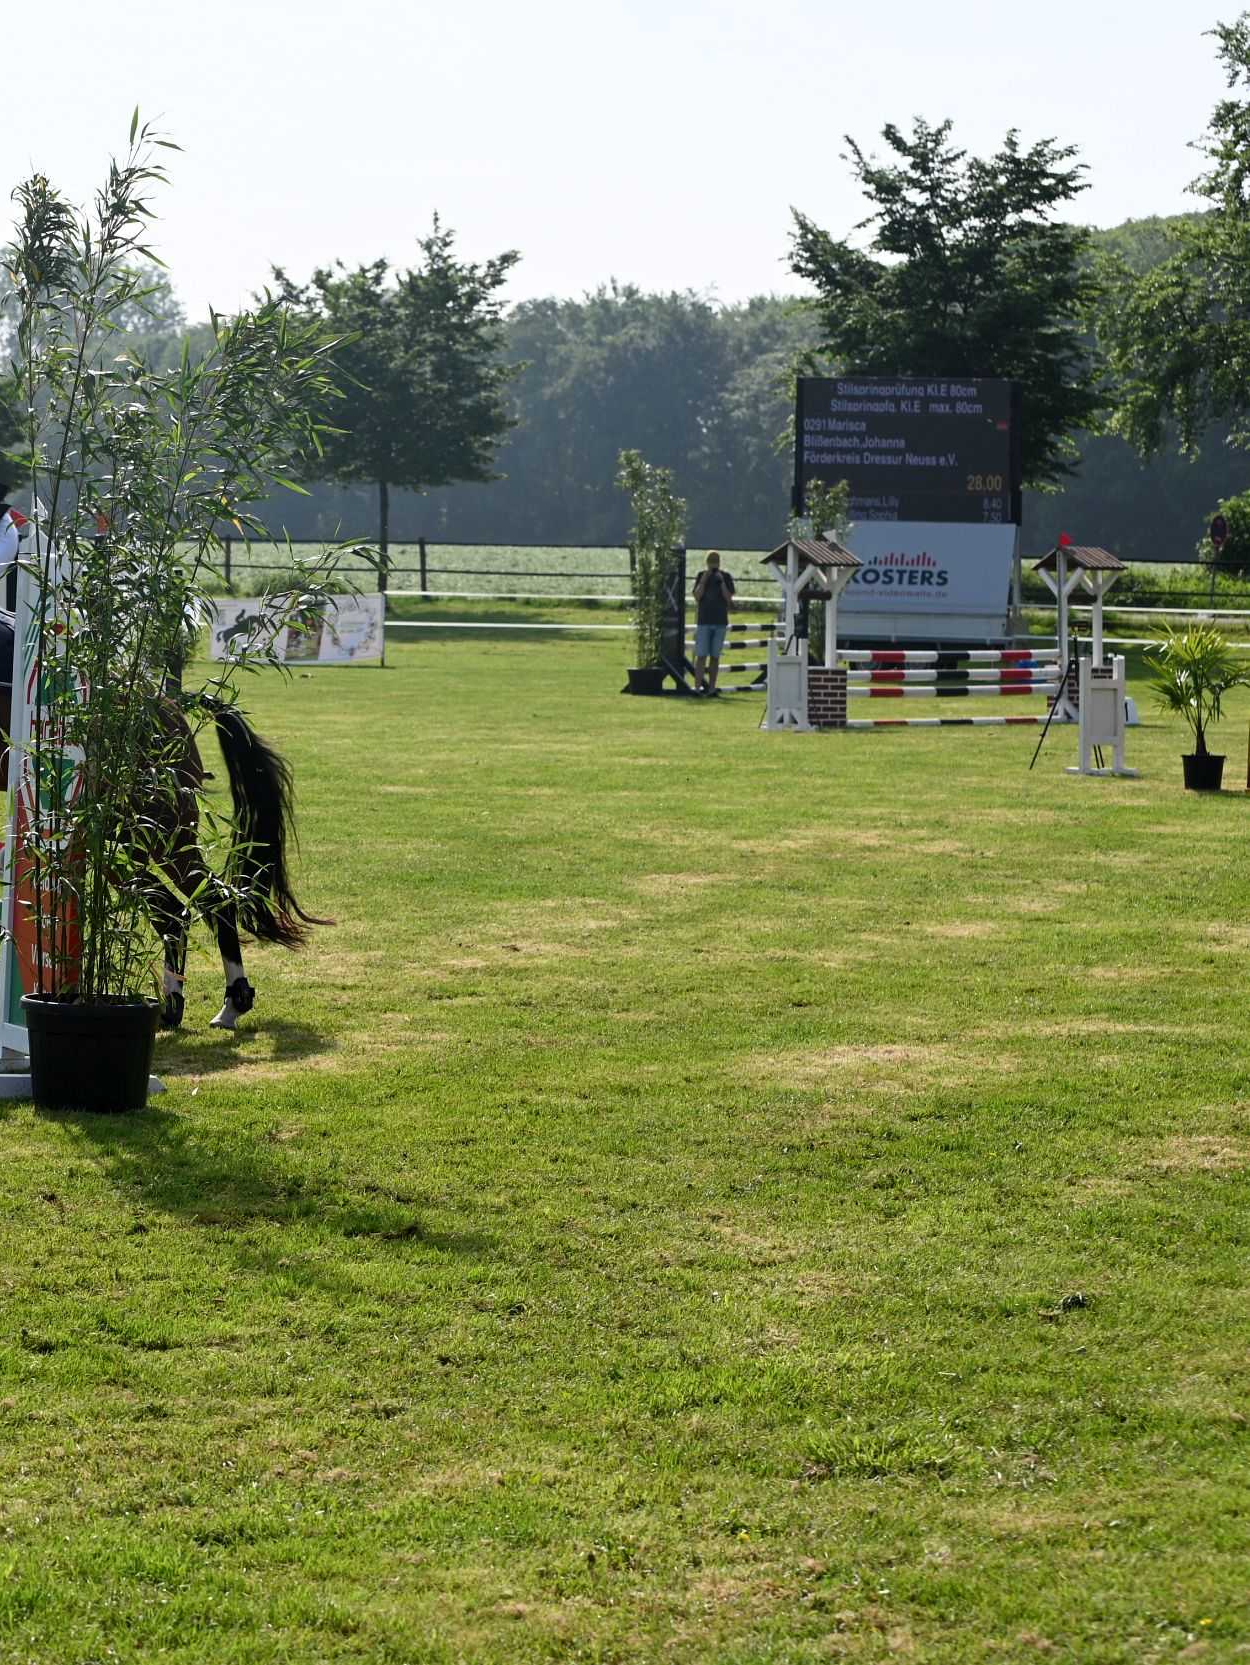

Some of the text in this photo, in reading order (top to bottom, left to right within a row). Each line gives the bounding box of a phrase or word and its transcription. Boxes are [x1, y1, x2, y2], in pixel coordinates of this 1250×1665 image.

[862, 451, 903, 465] Dressur
[904, 452, 937, 466] Neuss
[966, 474, 1002, 491] 28.00
